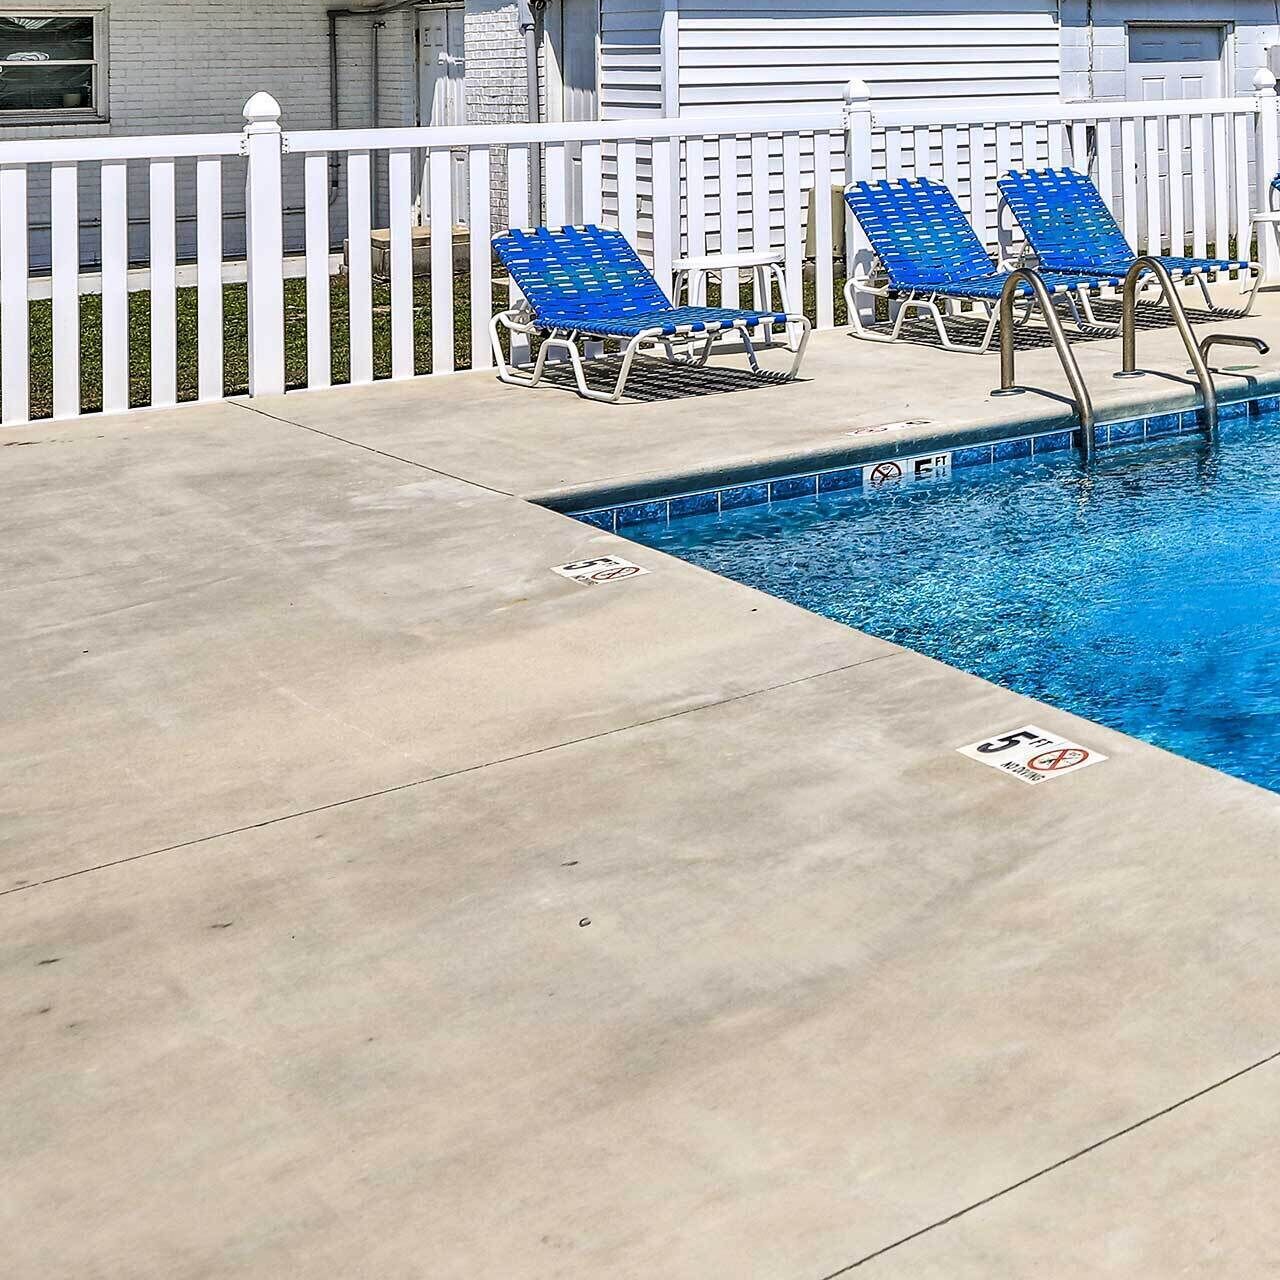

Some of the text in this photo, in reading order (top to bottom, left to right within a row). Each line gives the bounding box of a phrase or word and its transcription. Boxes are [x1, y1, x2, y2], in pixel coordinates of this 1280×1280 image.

[935, 455, 947, 467] FT
[562, 557, 613, 570] 5
[976, 730, 1053, 754] 5 FT
[1000, 760, 1045, 782] NO DIVING
